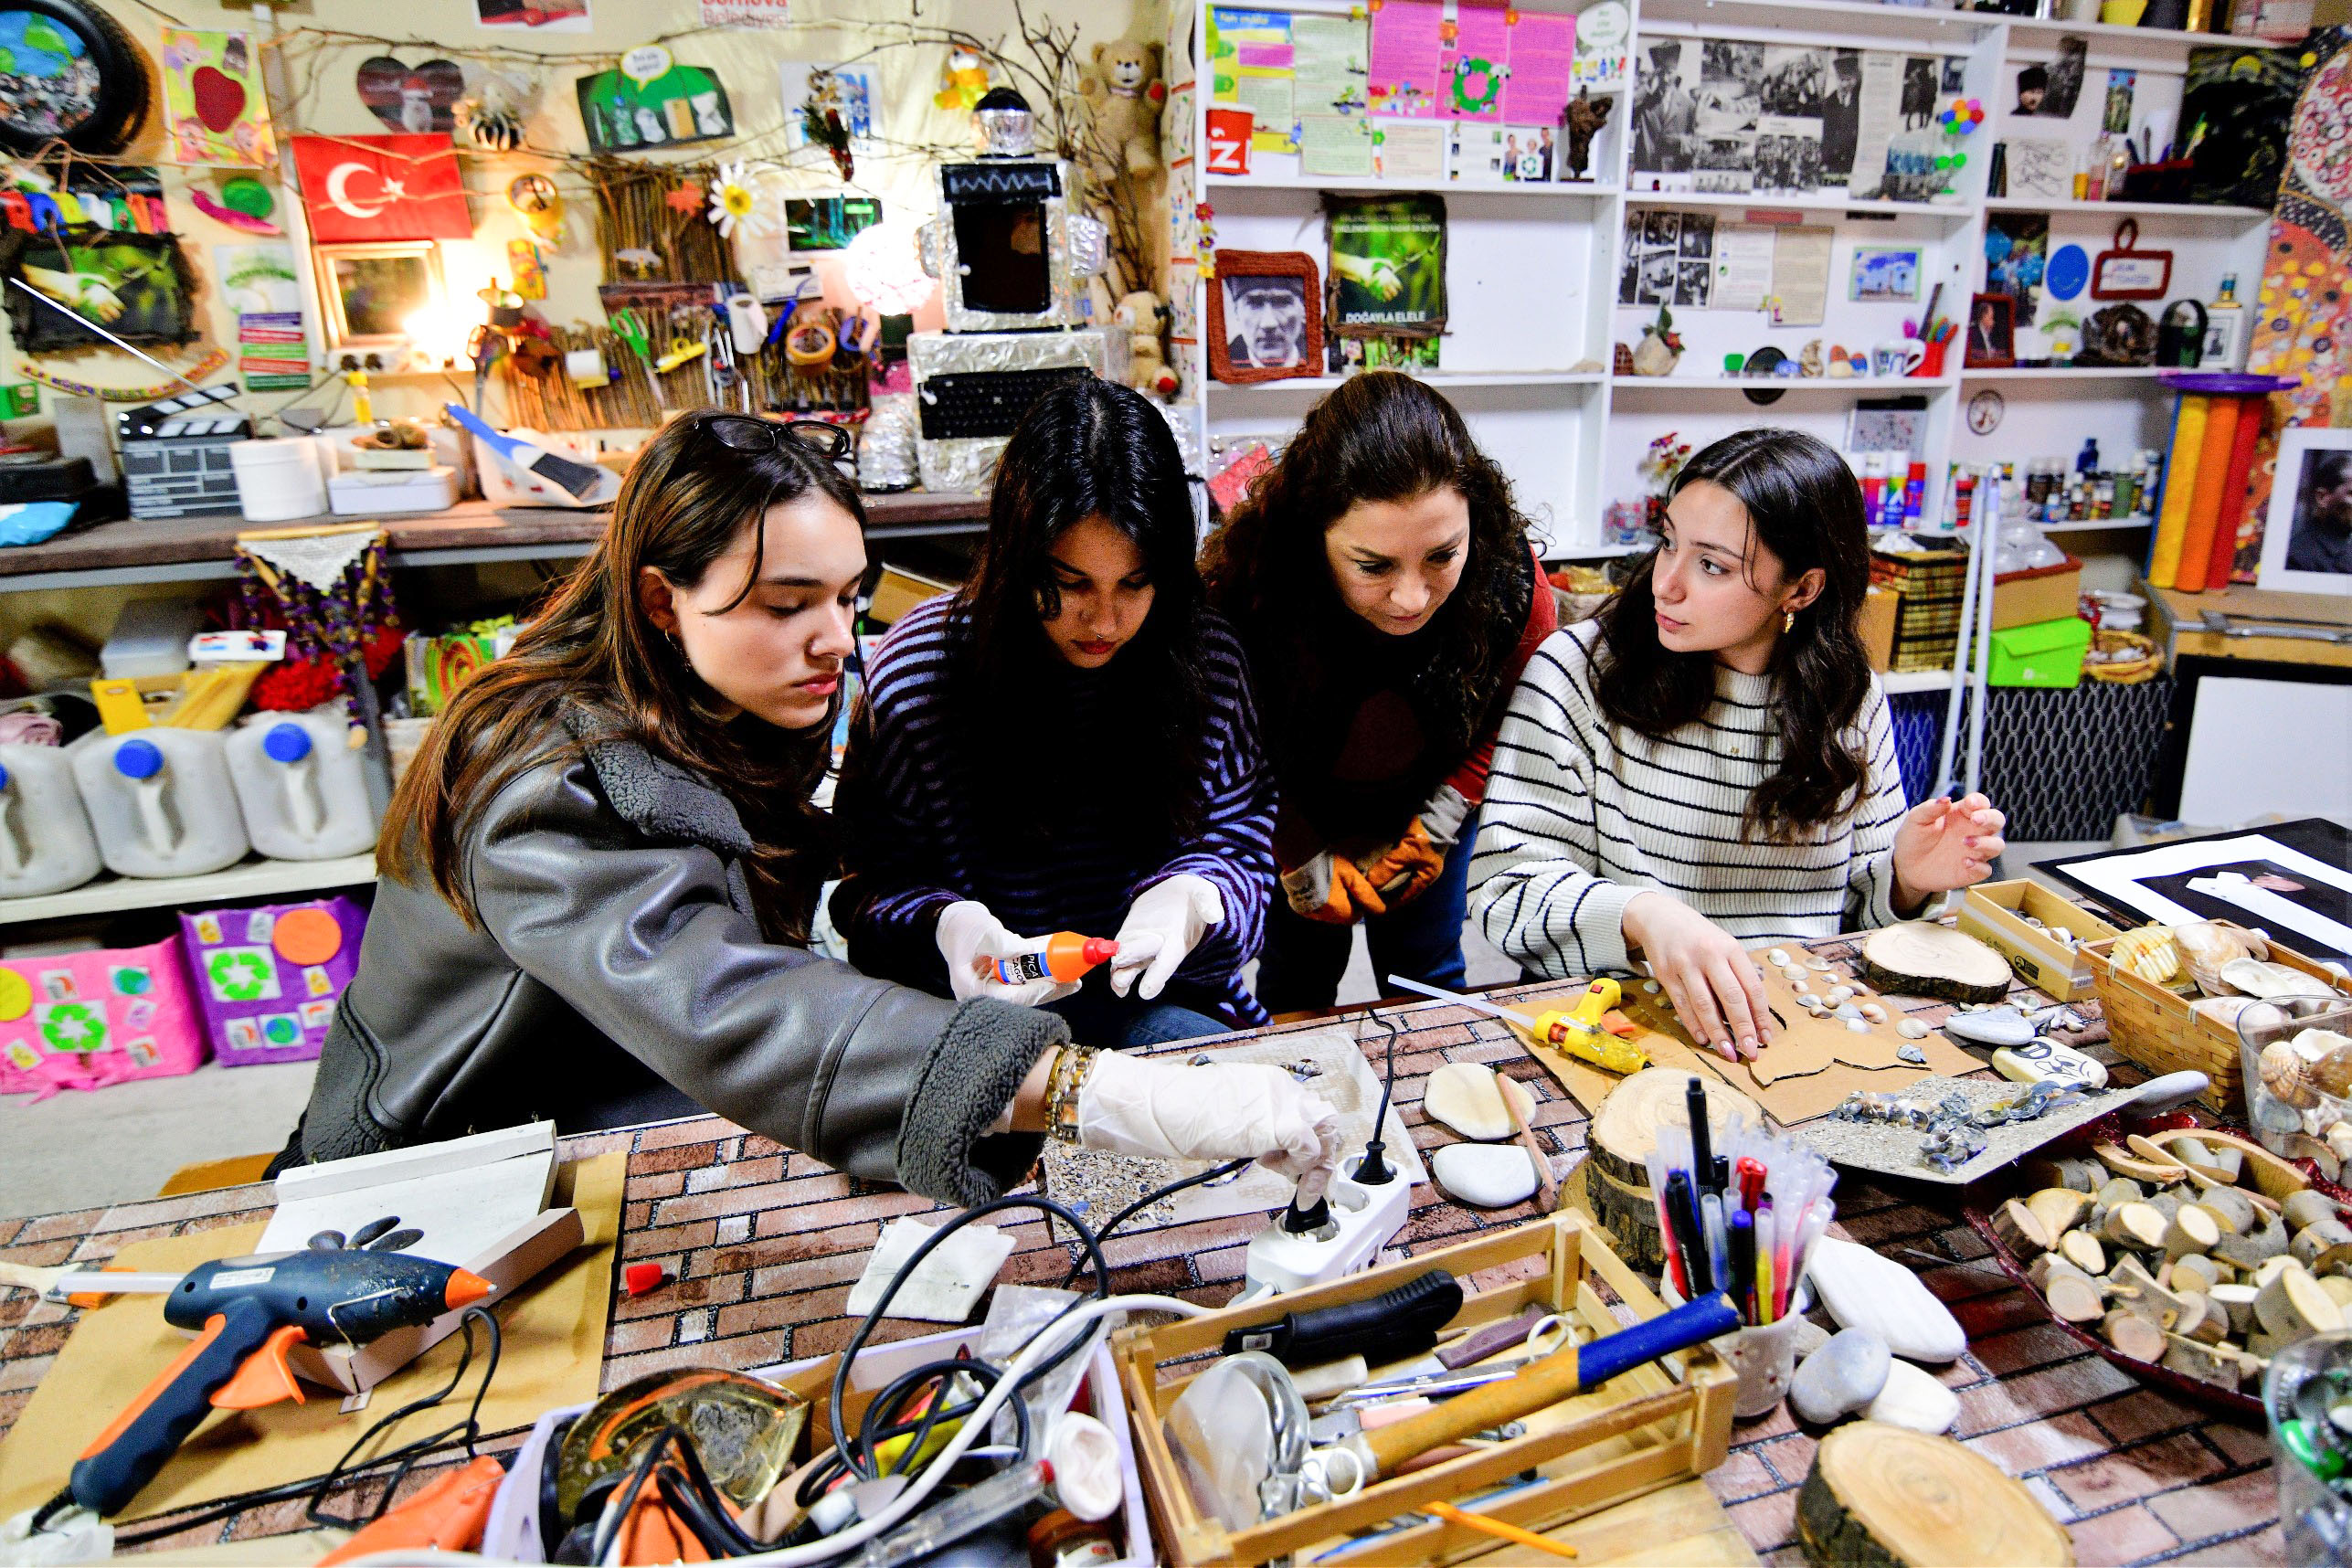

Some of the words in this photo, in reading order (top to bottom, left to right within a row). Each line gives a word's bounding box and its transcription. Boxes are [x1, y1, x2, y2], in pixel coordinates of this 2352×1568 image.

[1345, 310, 1394, 323] DOĞAYLA
[1394, 311, 1425, 323] ELELE
[1027, 955, 1039, 978] PICA
